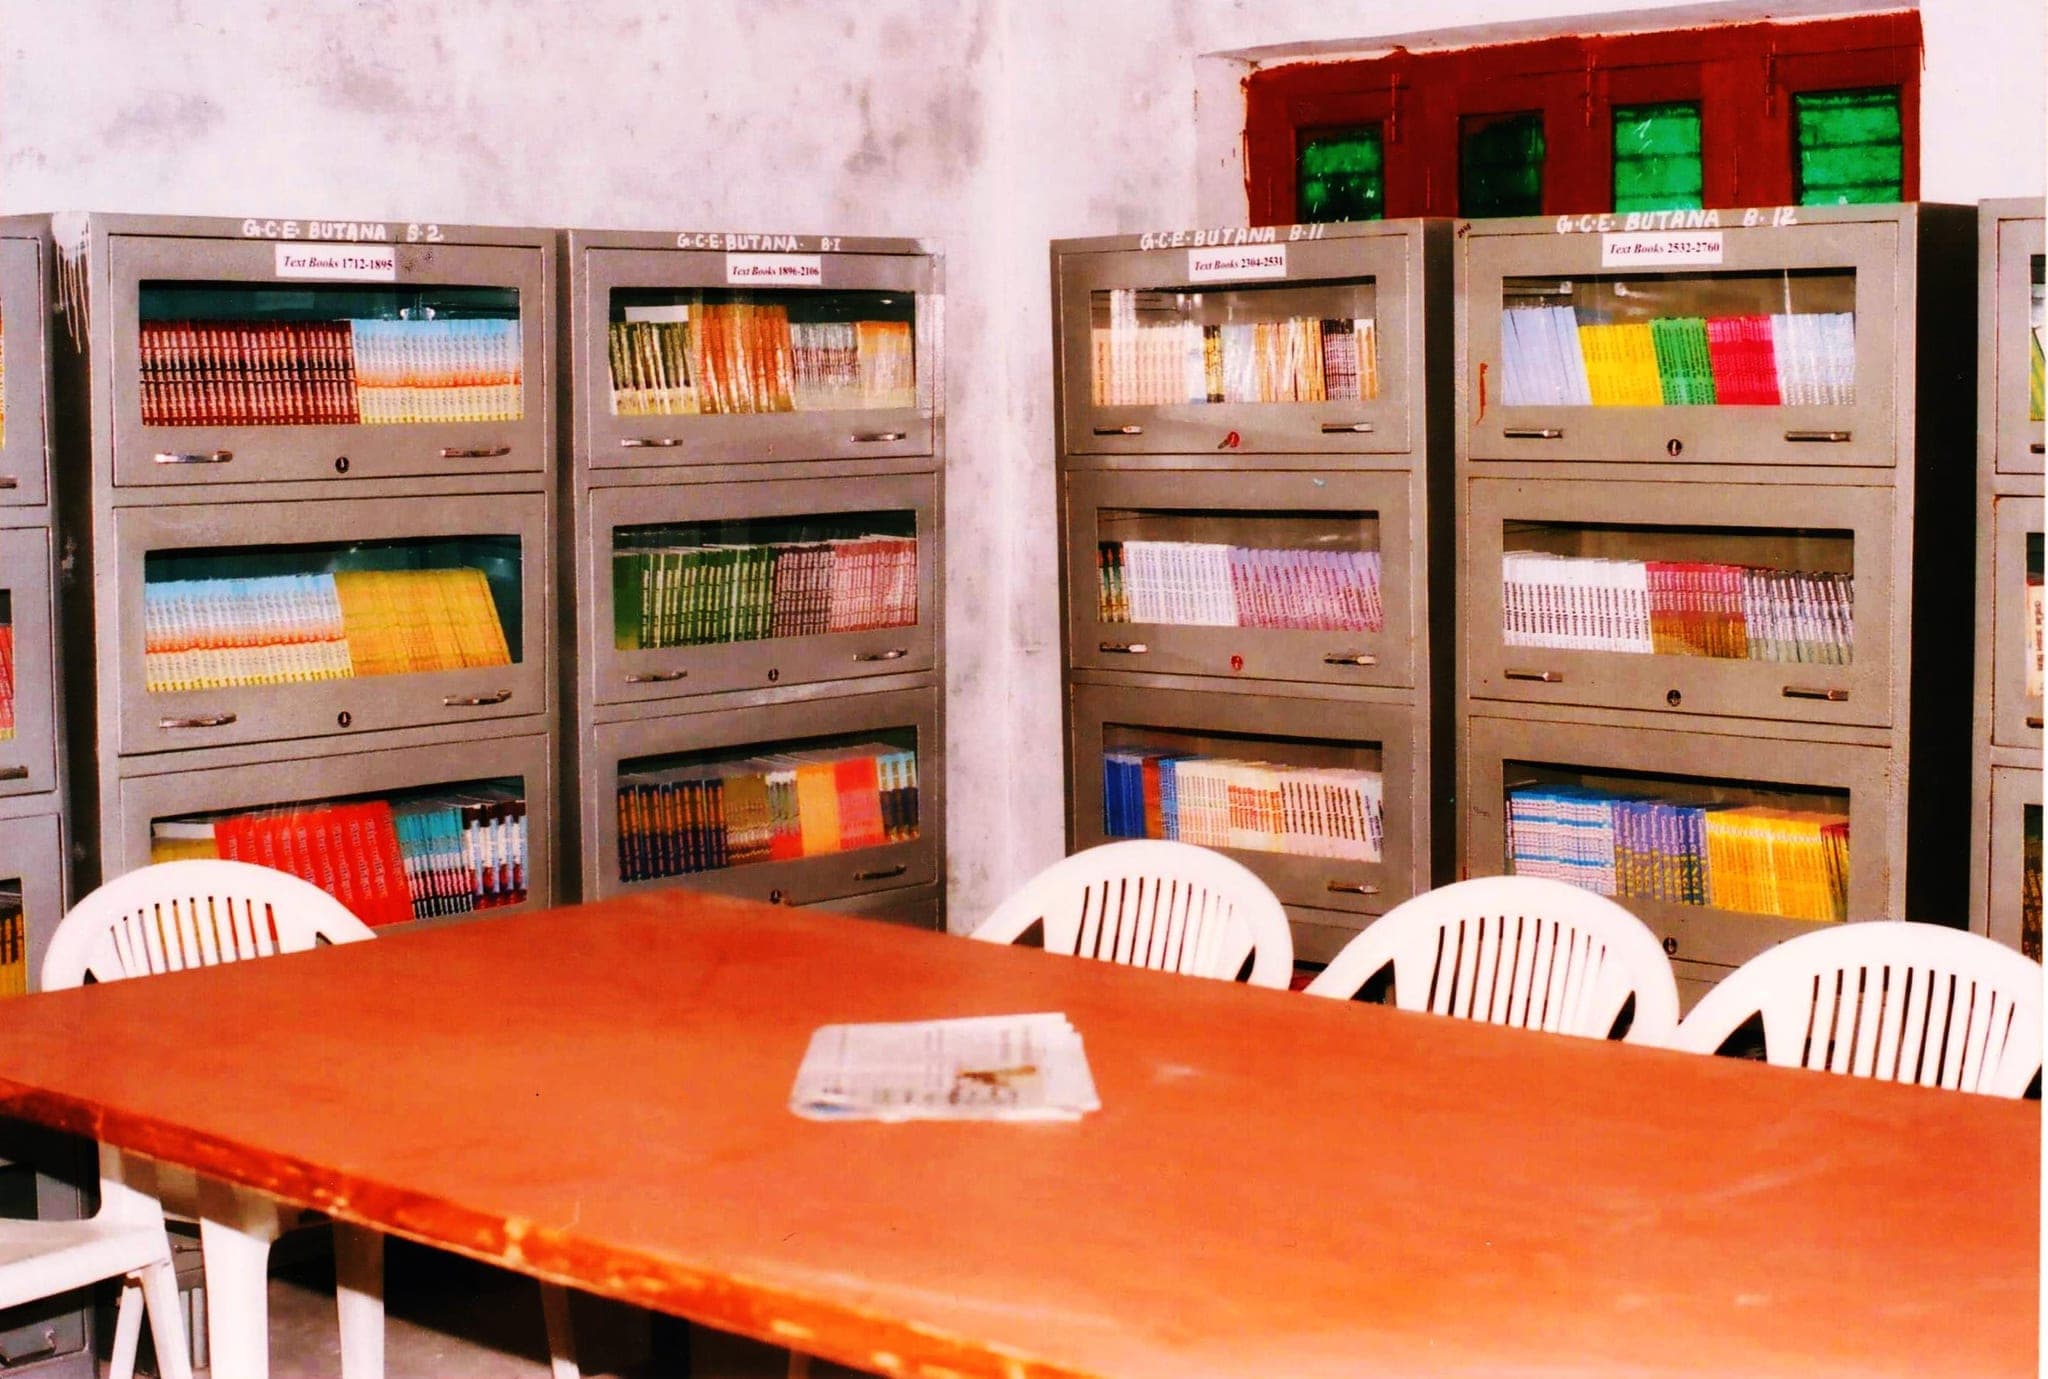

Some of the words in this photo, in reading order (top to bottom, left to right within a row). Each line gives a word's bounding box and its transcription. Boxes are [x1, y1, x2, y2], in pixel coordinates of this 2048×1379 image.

[1624, 208, 1720, 231] BUTANA
[308, 221, 387, 242] BUTANA
[1193, 226, 1276, 246] BUTANA
[1610, 244, 1631, 254] Text
[1633, 243, 1664, 254] Books
[1667, 242, 1720, 253] 2532-2760
[283, 256, 305, 268] Text
[309, 256, 339, 269] Books
[342, 257, 393, 270] 1712-1895
[1194, 261, 1212, 271] Text
[1214, 260, 1238, 270] Books
[731, 266, 750, 276] Text
[751, 266, 776, 276] Books
